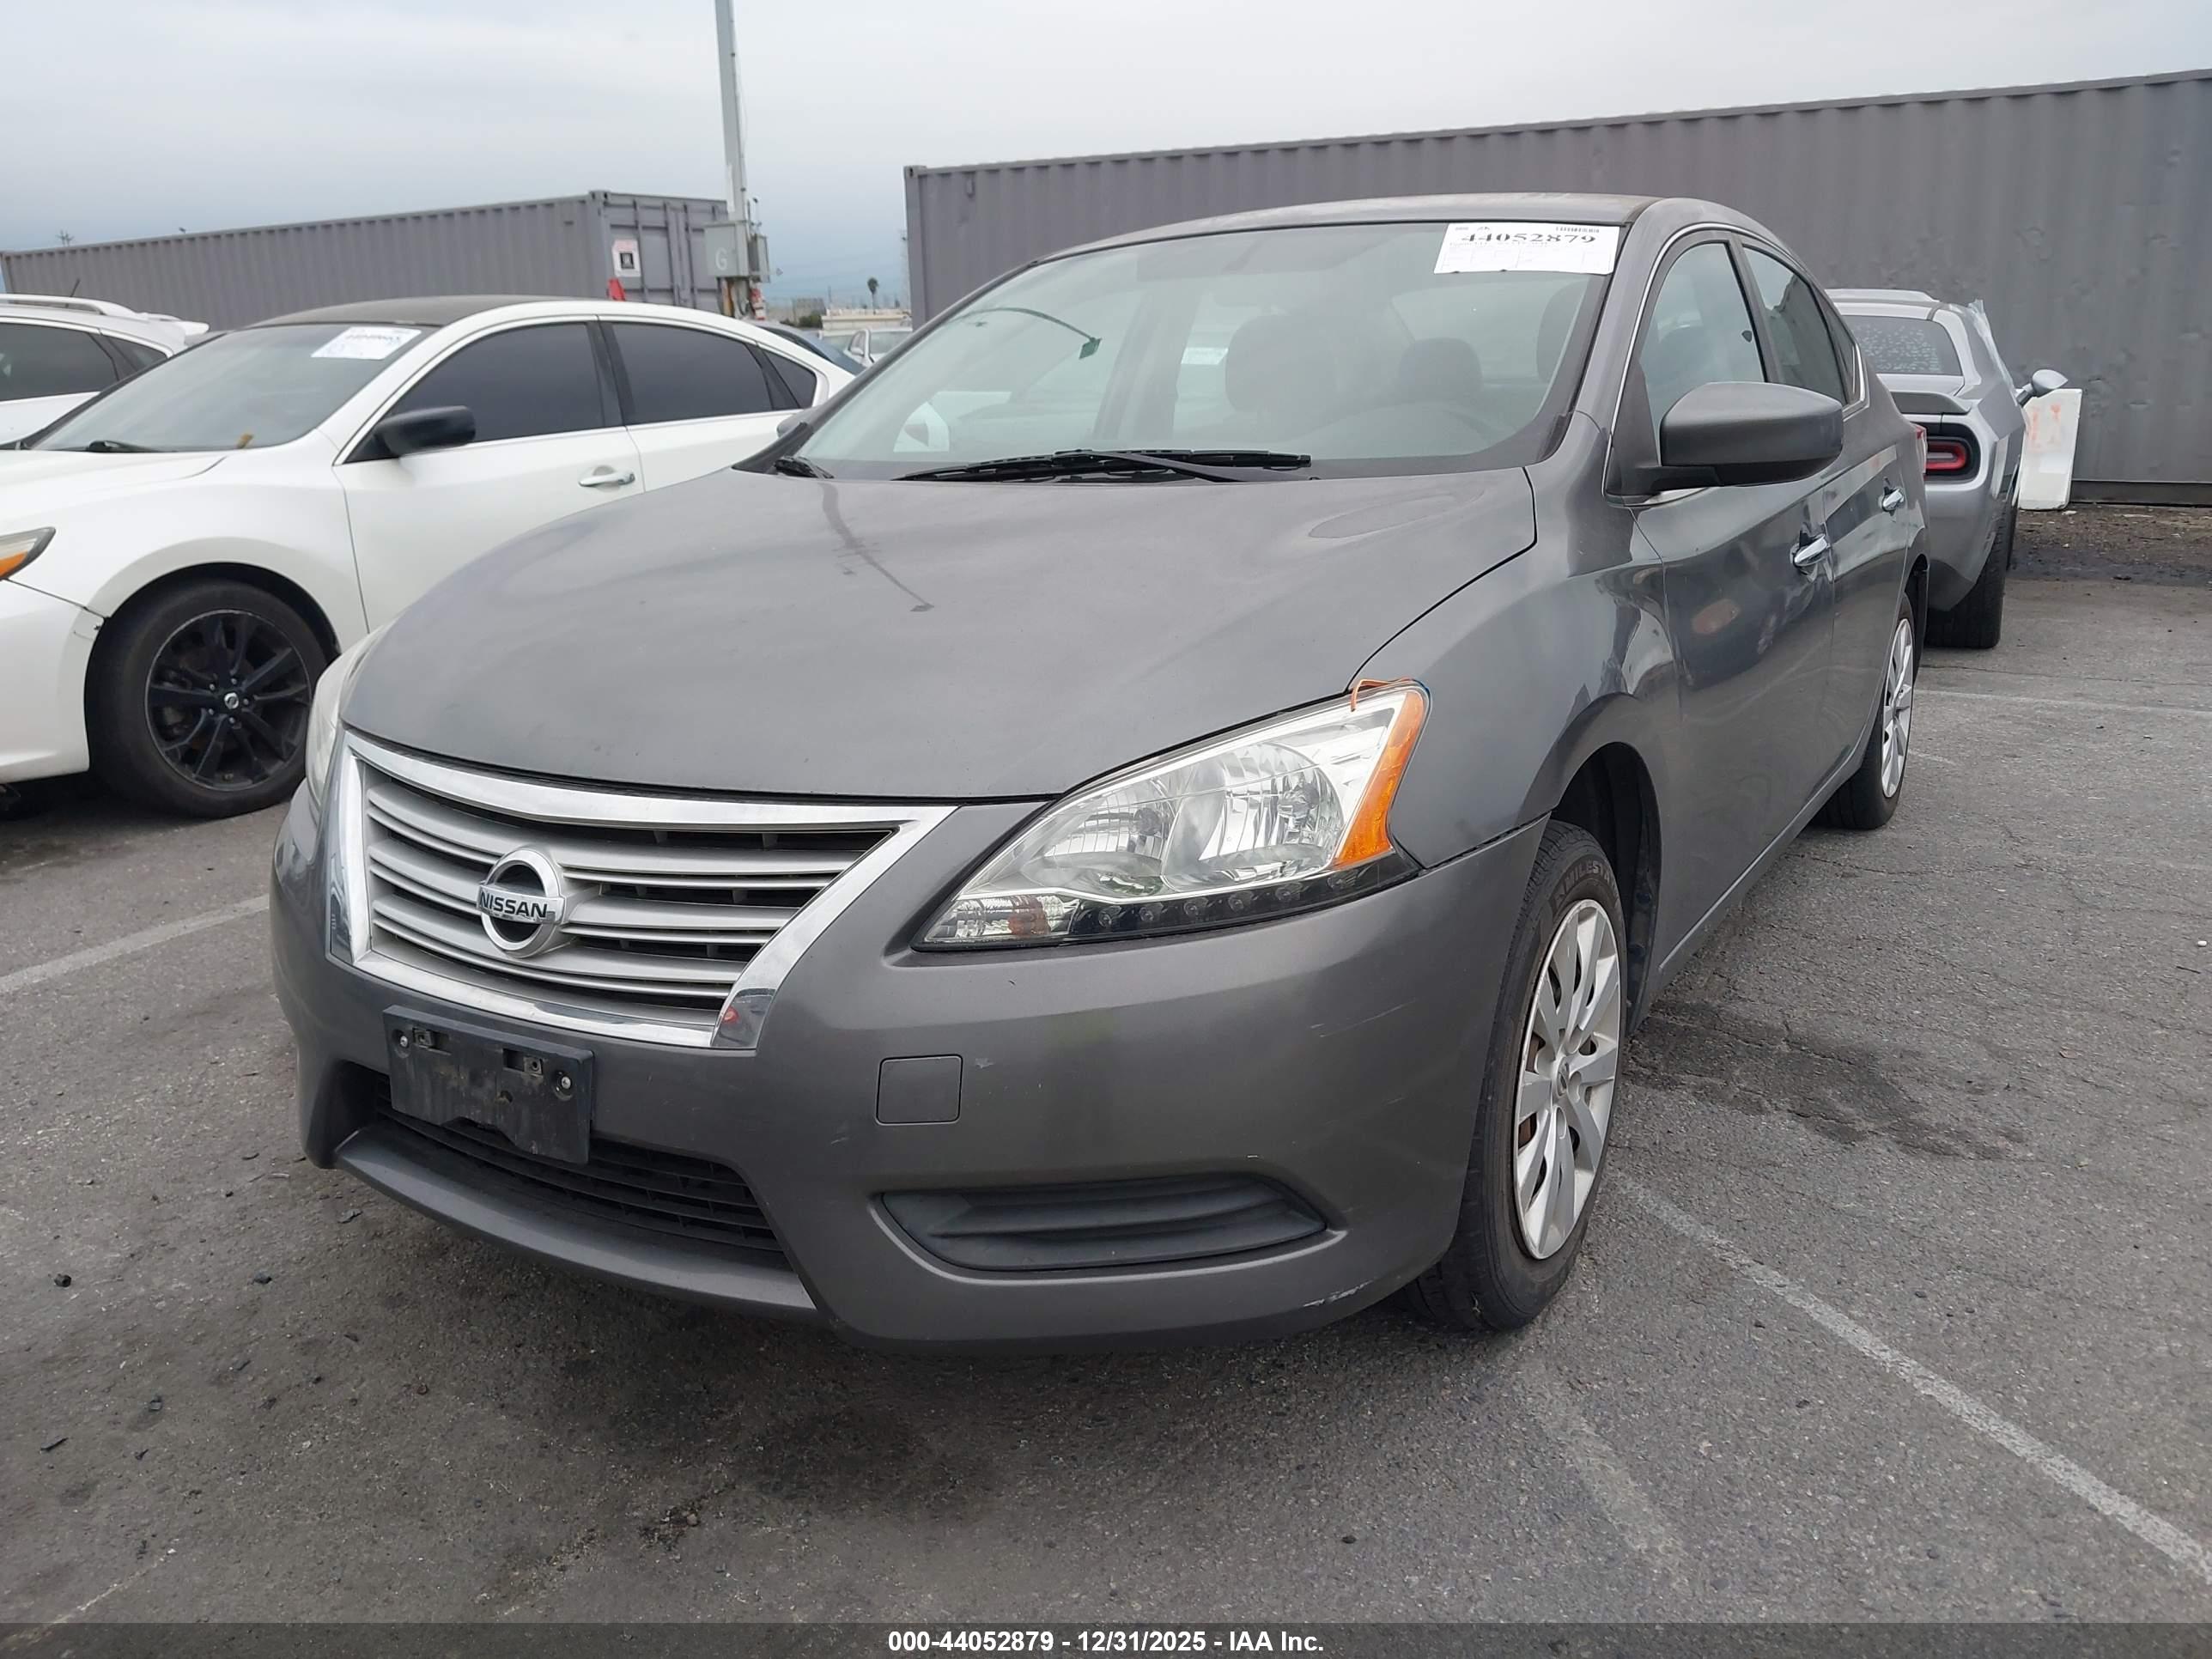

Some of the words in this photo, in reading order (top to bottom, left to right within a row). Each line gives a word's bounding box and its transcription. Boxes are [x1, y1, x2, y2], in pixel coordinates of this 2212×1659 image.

[1462, 233, 1596, 244] 44052879
[715, 247, 728, 270] G
[480, 891, 548, 918] NISSAN
